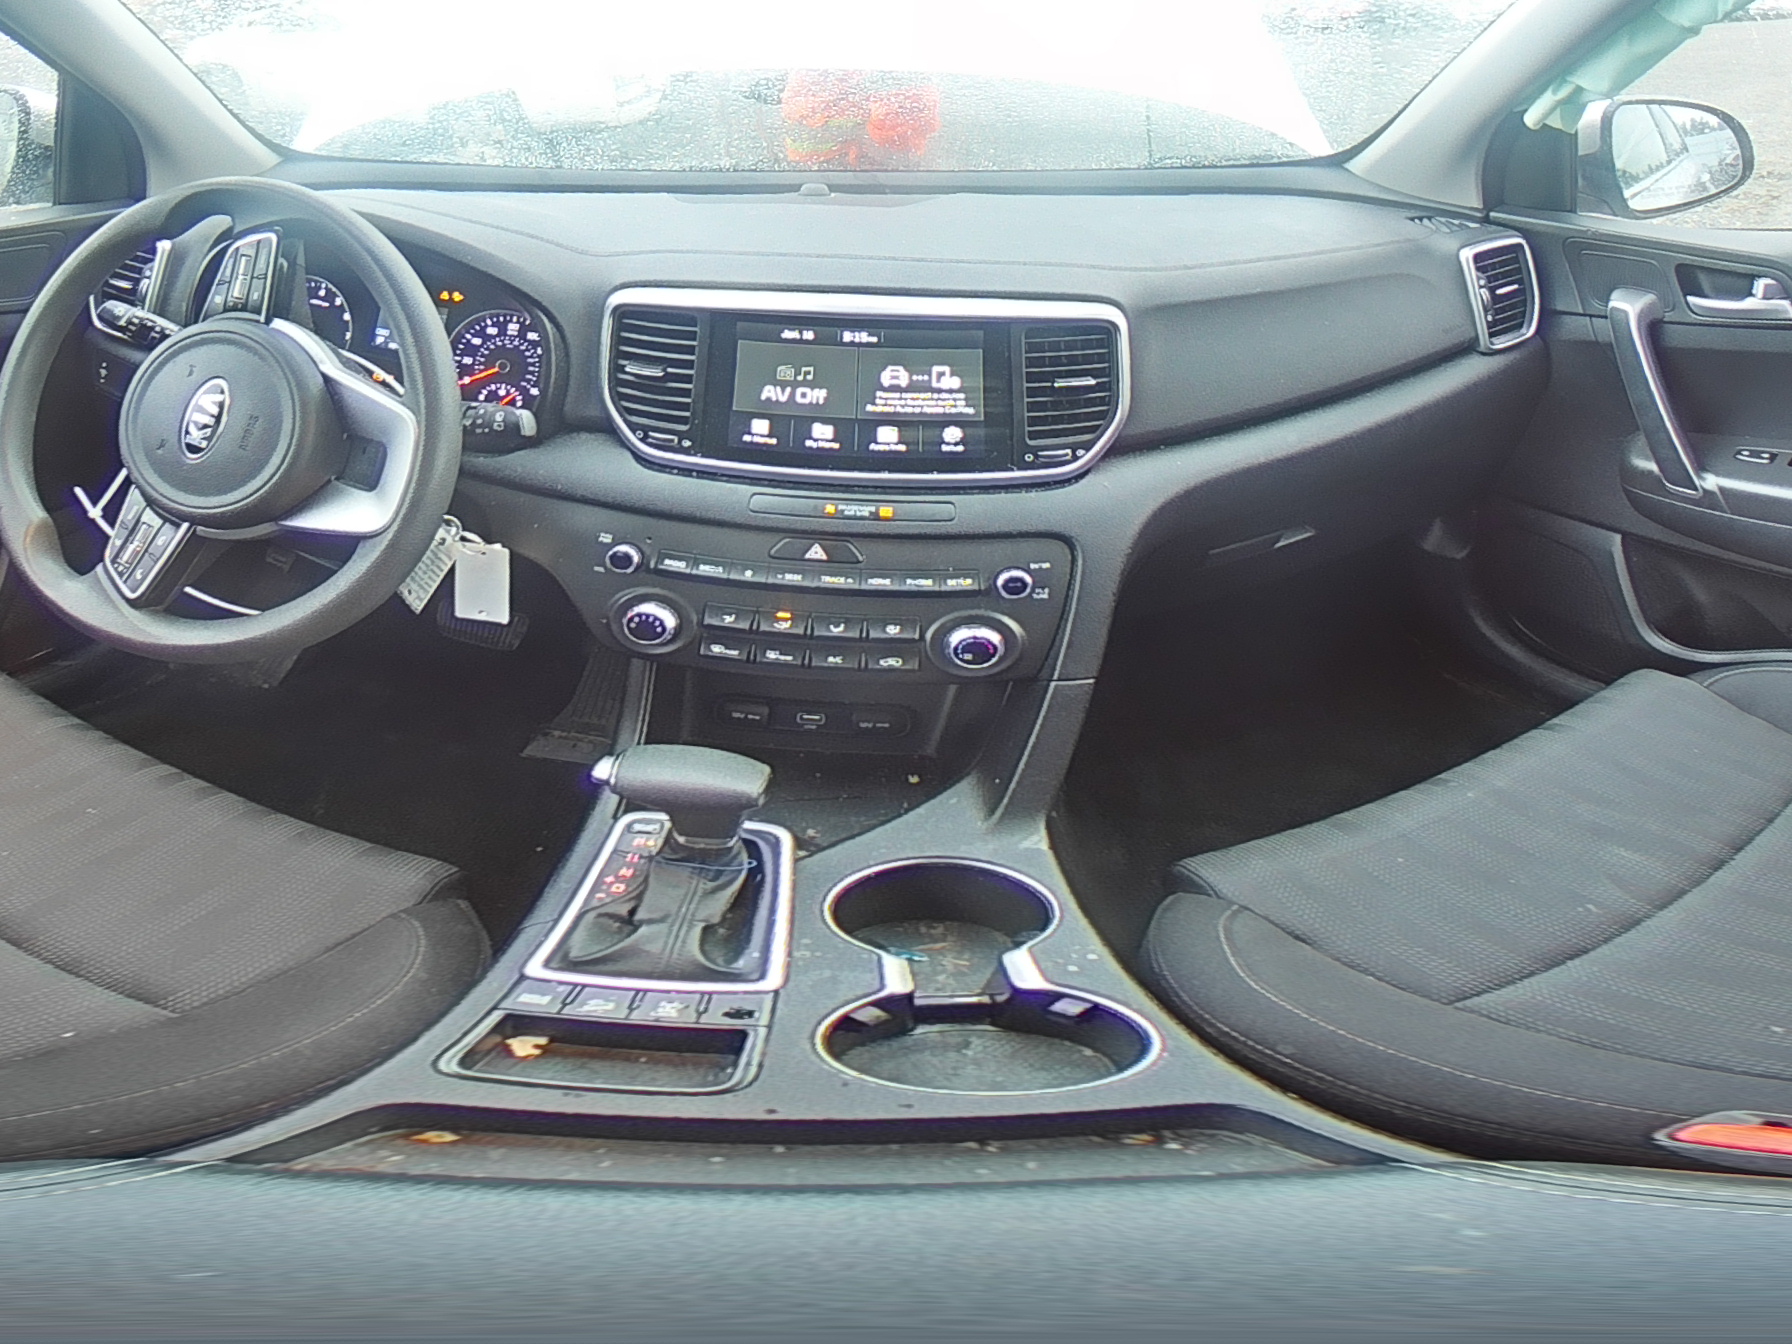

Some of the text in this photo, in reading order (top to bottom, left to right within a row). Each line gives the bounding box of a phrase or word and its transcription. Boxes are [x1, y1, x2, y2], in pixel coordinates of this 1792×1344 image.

[760, 385, 827, 405] AV Off
[185, 393, 225, 449] KIA
